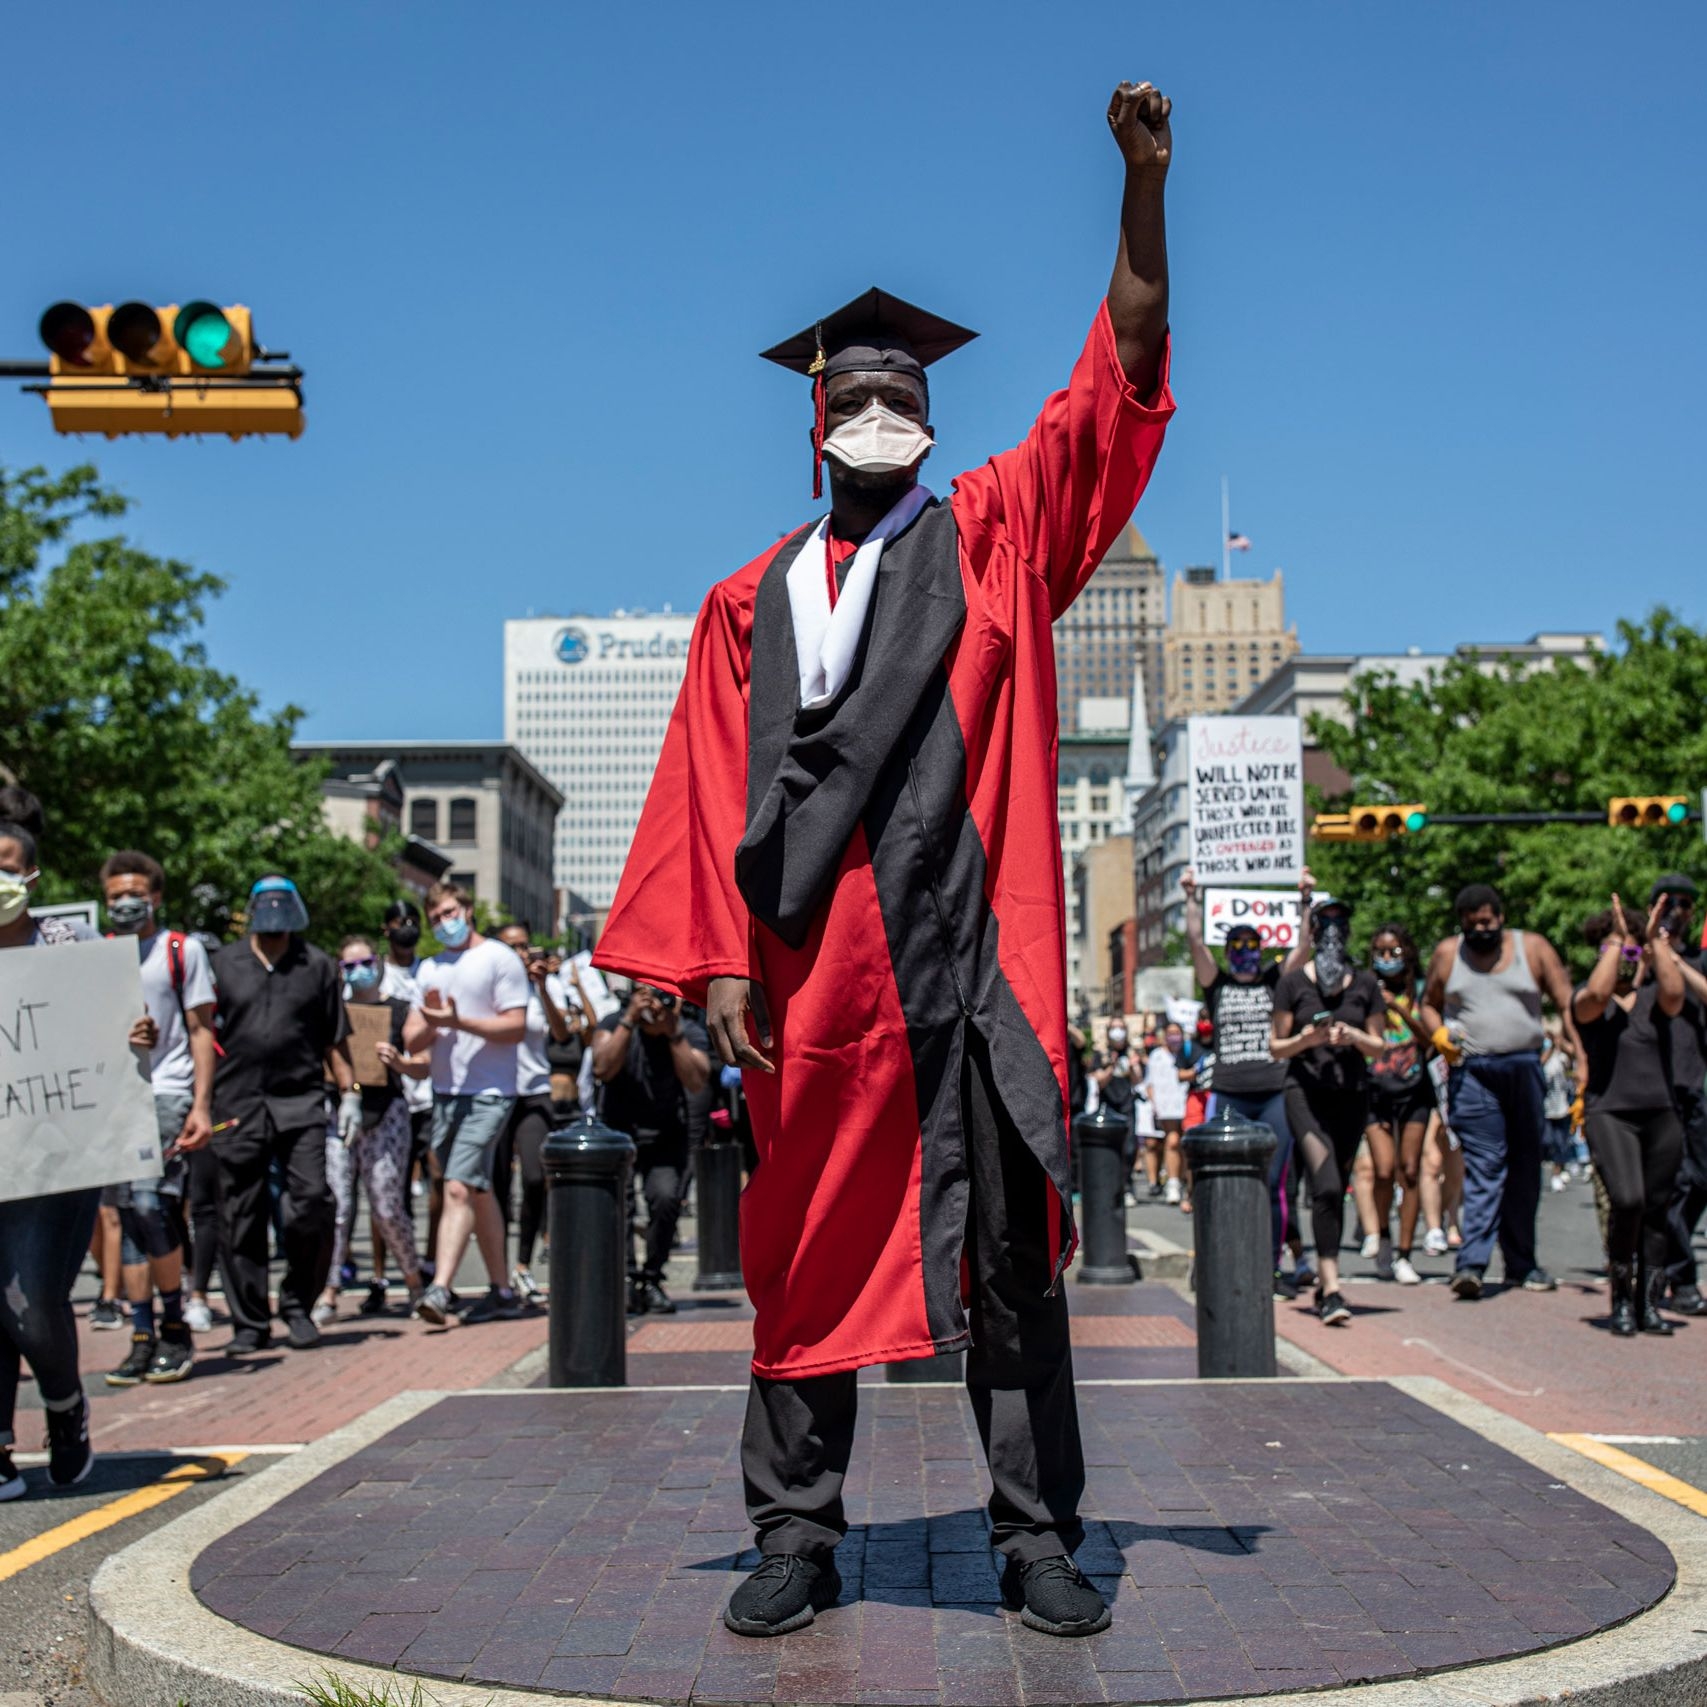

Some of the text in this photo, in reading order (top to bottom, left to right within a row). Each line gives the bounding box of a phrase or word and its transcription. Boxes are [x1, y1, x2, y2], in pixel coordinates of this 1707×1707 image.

[1195, 726, 1291, 761] Justice
[1196, 763, 1297, 783] WILL NOT BE
[1196, 786, 1288, 804] SERVED UNTIL
[1197, 804, 1287, 821] THOSE WHO ARE
[1197, 844, 1211, 858] AS
[1279, 839, 1292, 850] AS
[1197, 858, 1239, 874] THOSE
[1245, 856, 1270, 871] WHO
[0, 1062, 105, 1119] ATHE"
